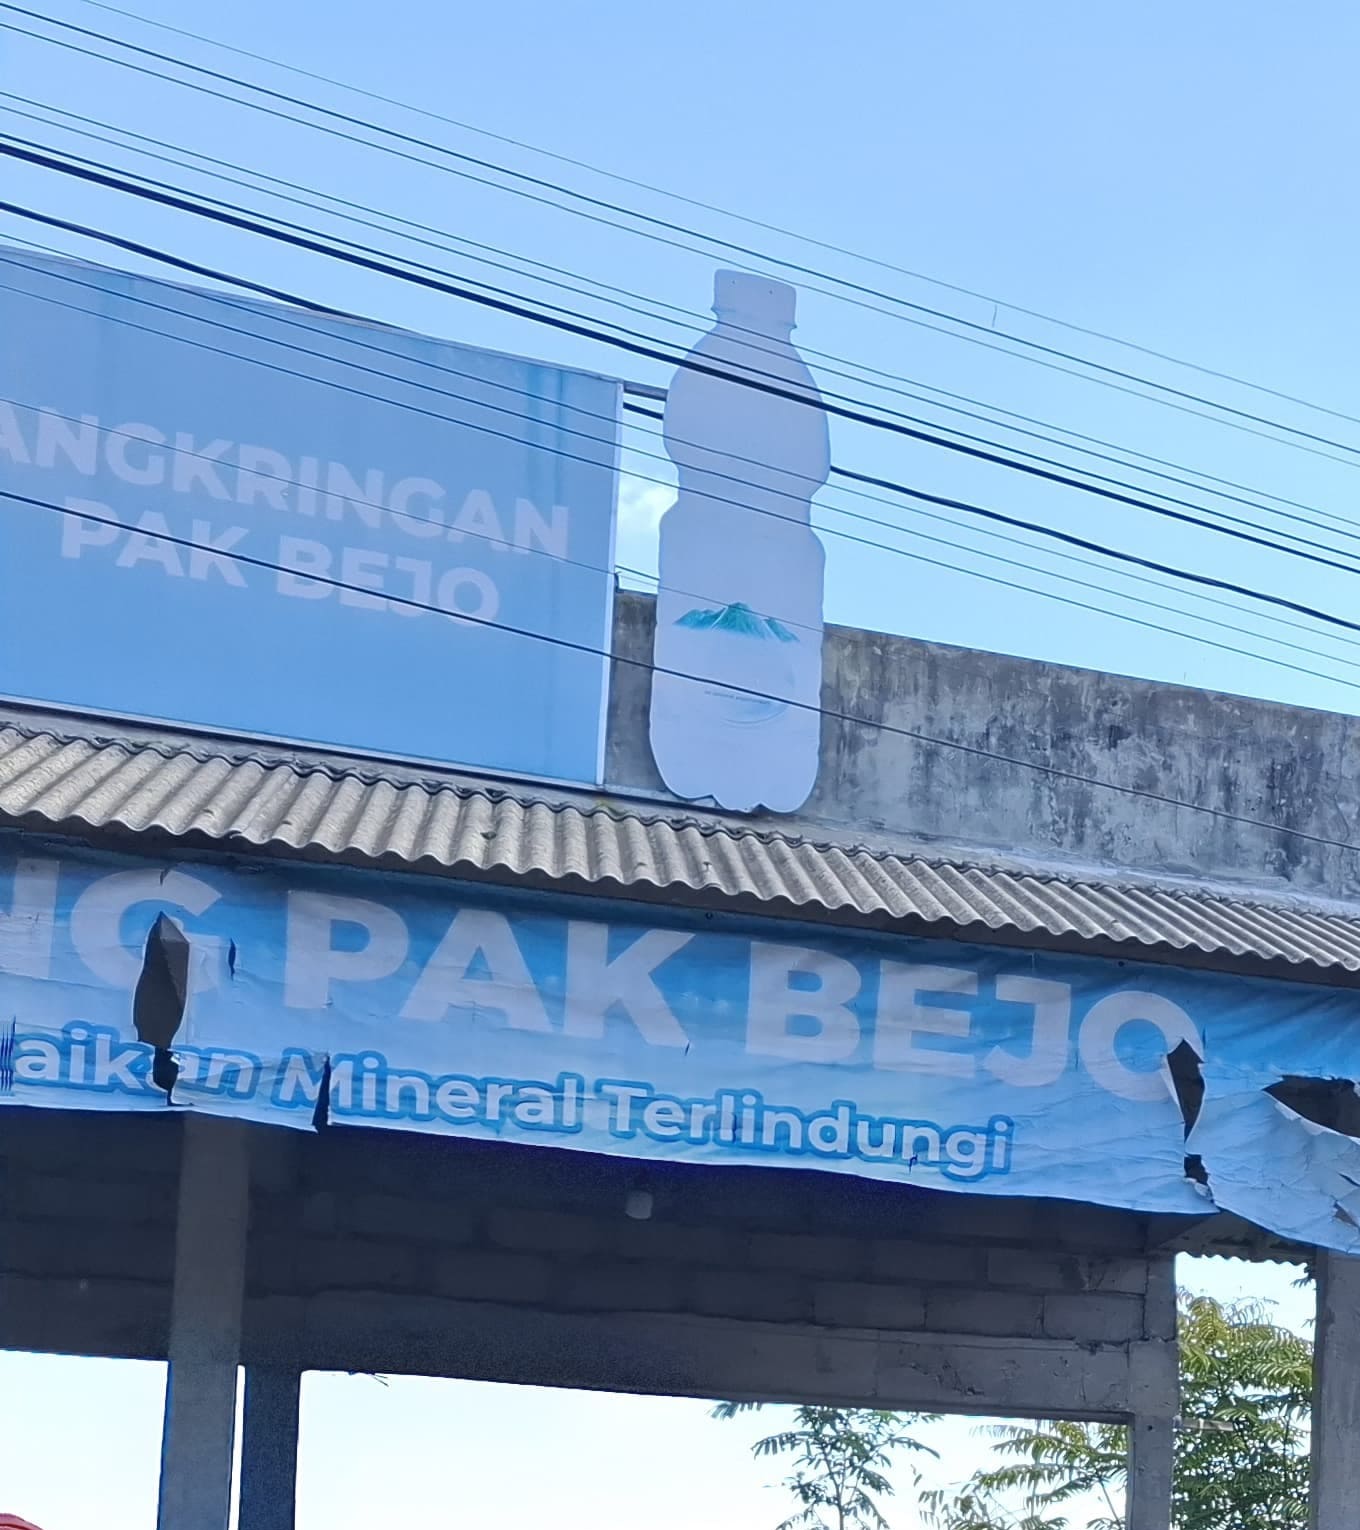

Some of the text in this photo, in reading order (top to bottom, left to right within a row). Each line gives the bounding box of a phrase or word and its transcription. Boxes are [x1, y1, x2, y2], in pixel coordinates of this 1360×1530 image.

[61, 496, 499, 627] PAK BEJO
[283, 890, 695, 1051] PAK
[746, 940, 1202, 1102] BEJO
[279, 1054, 577, 1126] Mineral
[600, 1084, 1009, 1178] Terlindungi
